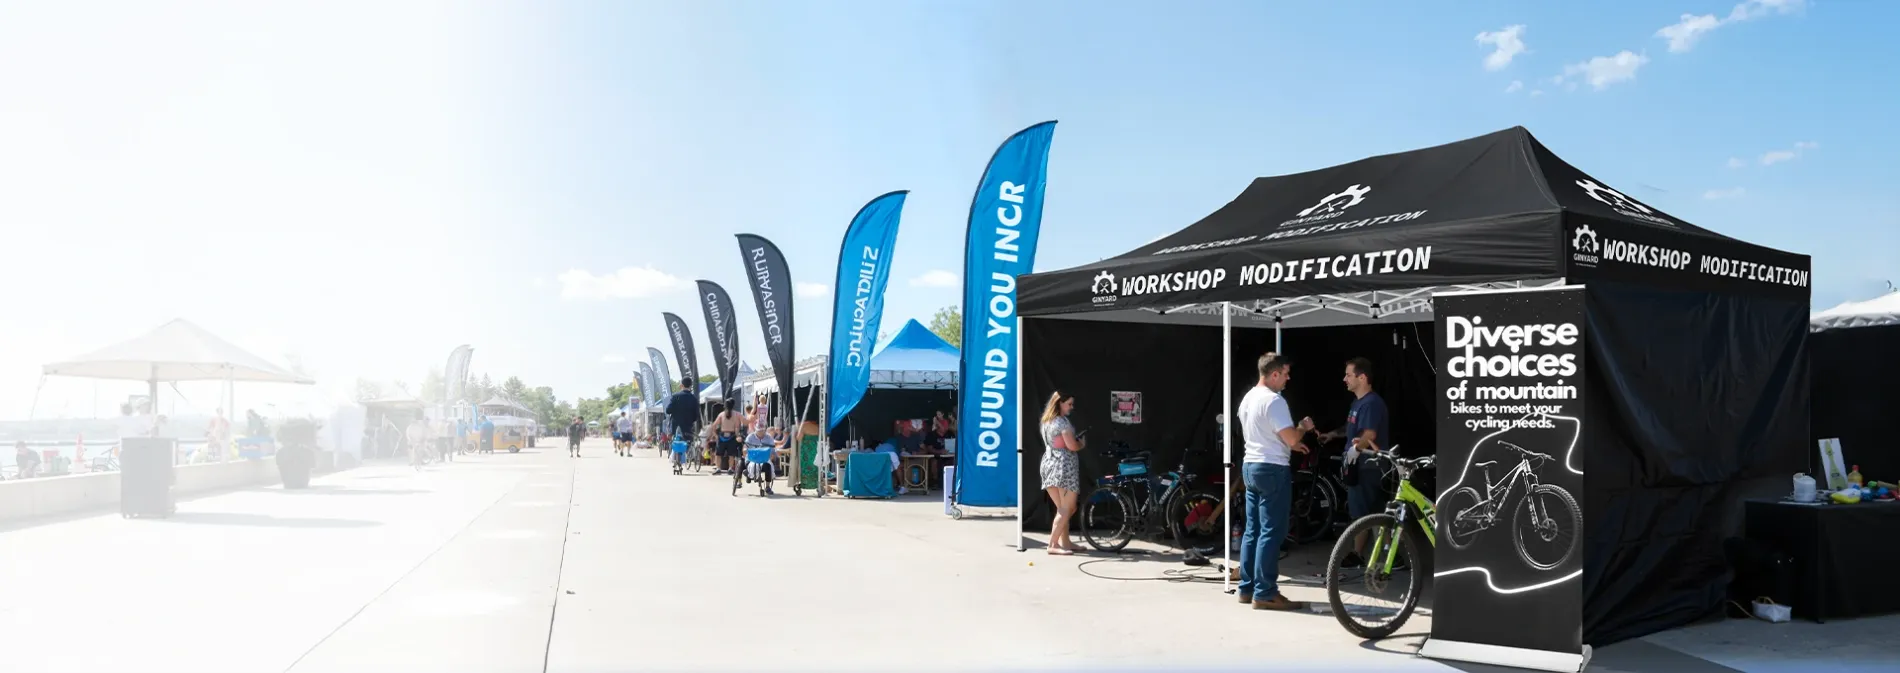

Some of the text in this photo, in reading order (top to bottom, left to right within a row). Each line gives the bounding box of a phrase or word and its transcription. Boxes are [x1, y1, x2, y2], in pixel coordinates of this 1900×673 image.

[1122, 246, 1432, 296] WORKSHOP MODIFICATION
[1573, 253, 1599, 264] GINYARD
[1603, 238, 1809, 288] WORKSHOP MODIFICATION
[1091, 295, 1117, 304] GINYARD
[976, 180, 1026, 467] ROUUND YOU INCR
[1446, 315, 1579, 349] Diverse
[1447, 344, 1577, 378] choices
[1446, 379, 1577, 400] of mountain
[1450, 402, 1562, 417] bikes to meet your
[1465, 415, 1556, 432] cycling needs.
